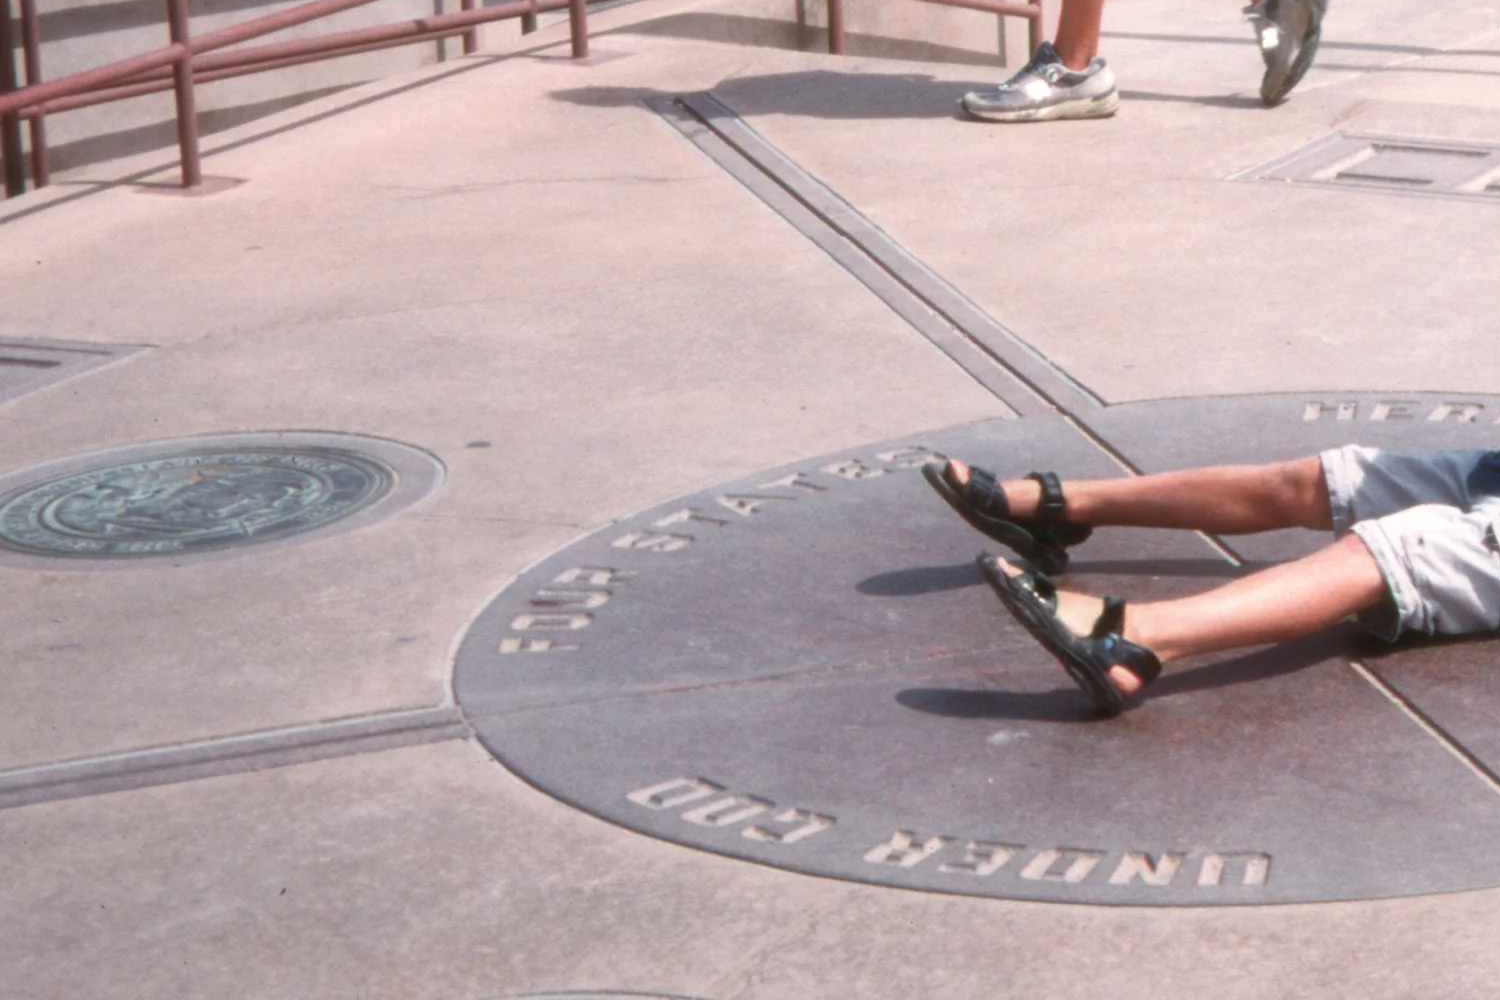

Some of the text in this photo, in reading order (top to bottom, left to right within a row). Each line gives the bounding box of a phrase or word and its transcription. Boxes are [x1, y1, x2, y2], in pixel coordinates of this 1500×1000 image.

[499, 564, 640, 655] FOUR
[611, 444, 950, 554] STATES
[626, 776, 1273, 887] UNDER GOD
